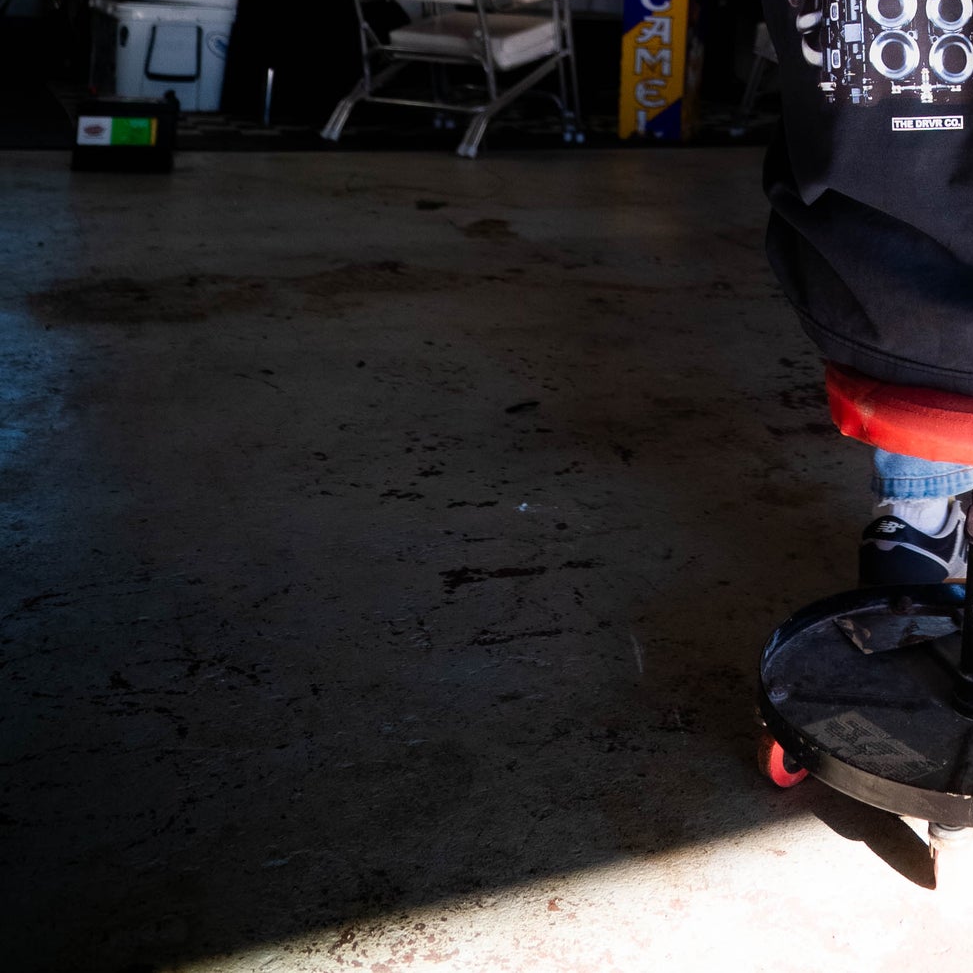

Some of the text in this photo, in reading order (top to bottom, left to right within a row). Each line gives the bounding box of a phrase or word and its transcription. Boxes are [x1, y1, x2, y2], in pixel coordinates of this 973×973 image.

[894, 118, 961, 129] THE DRVR CO.
